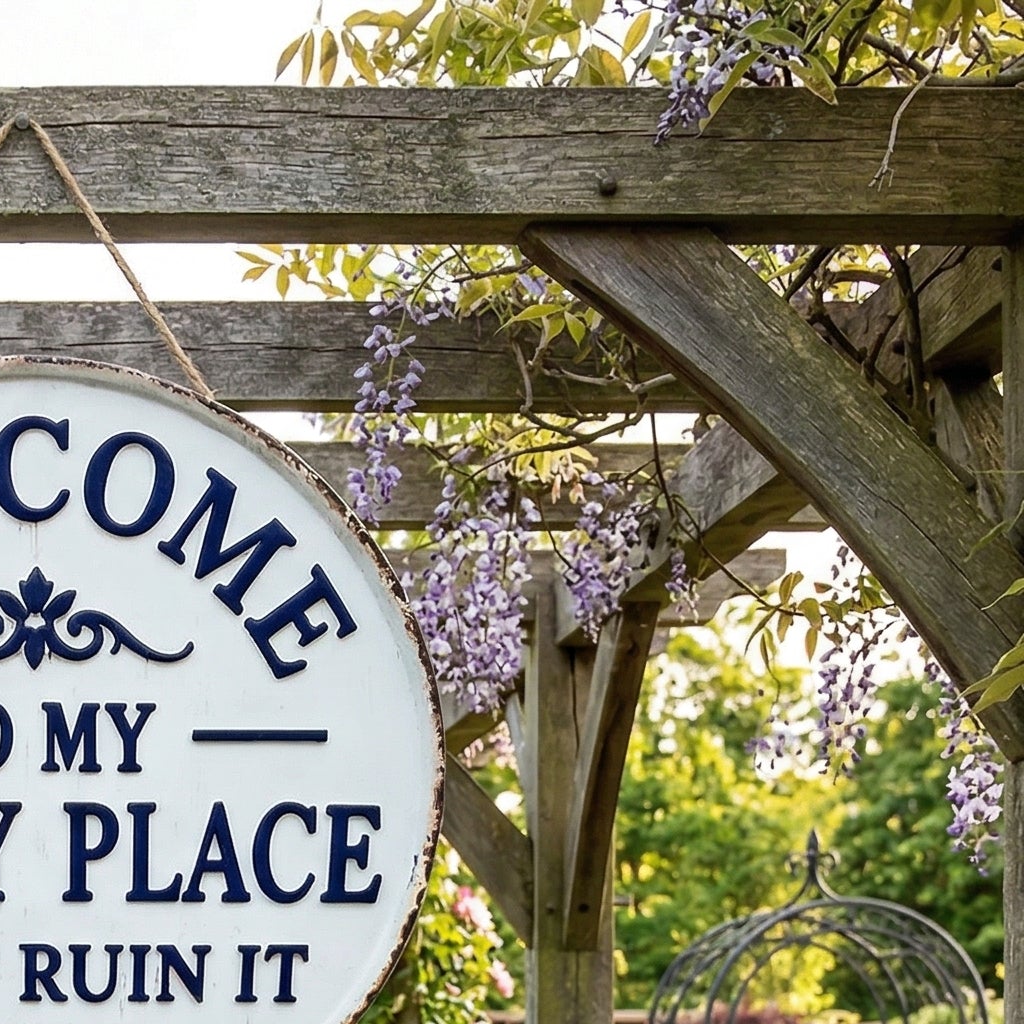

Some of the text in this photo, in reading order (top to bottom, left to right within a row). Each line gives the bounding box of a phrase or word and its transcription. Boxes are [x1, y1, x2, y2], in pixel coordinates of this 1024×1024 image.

[41, 701, 157, 774] MY
[61, 801, 383, 905] PLACE
[19, 944, 212, 1004] RUIN
[234, 944, 310, 1004] IT
